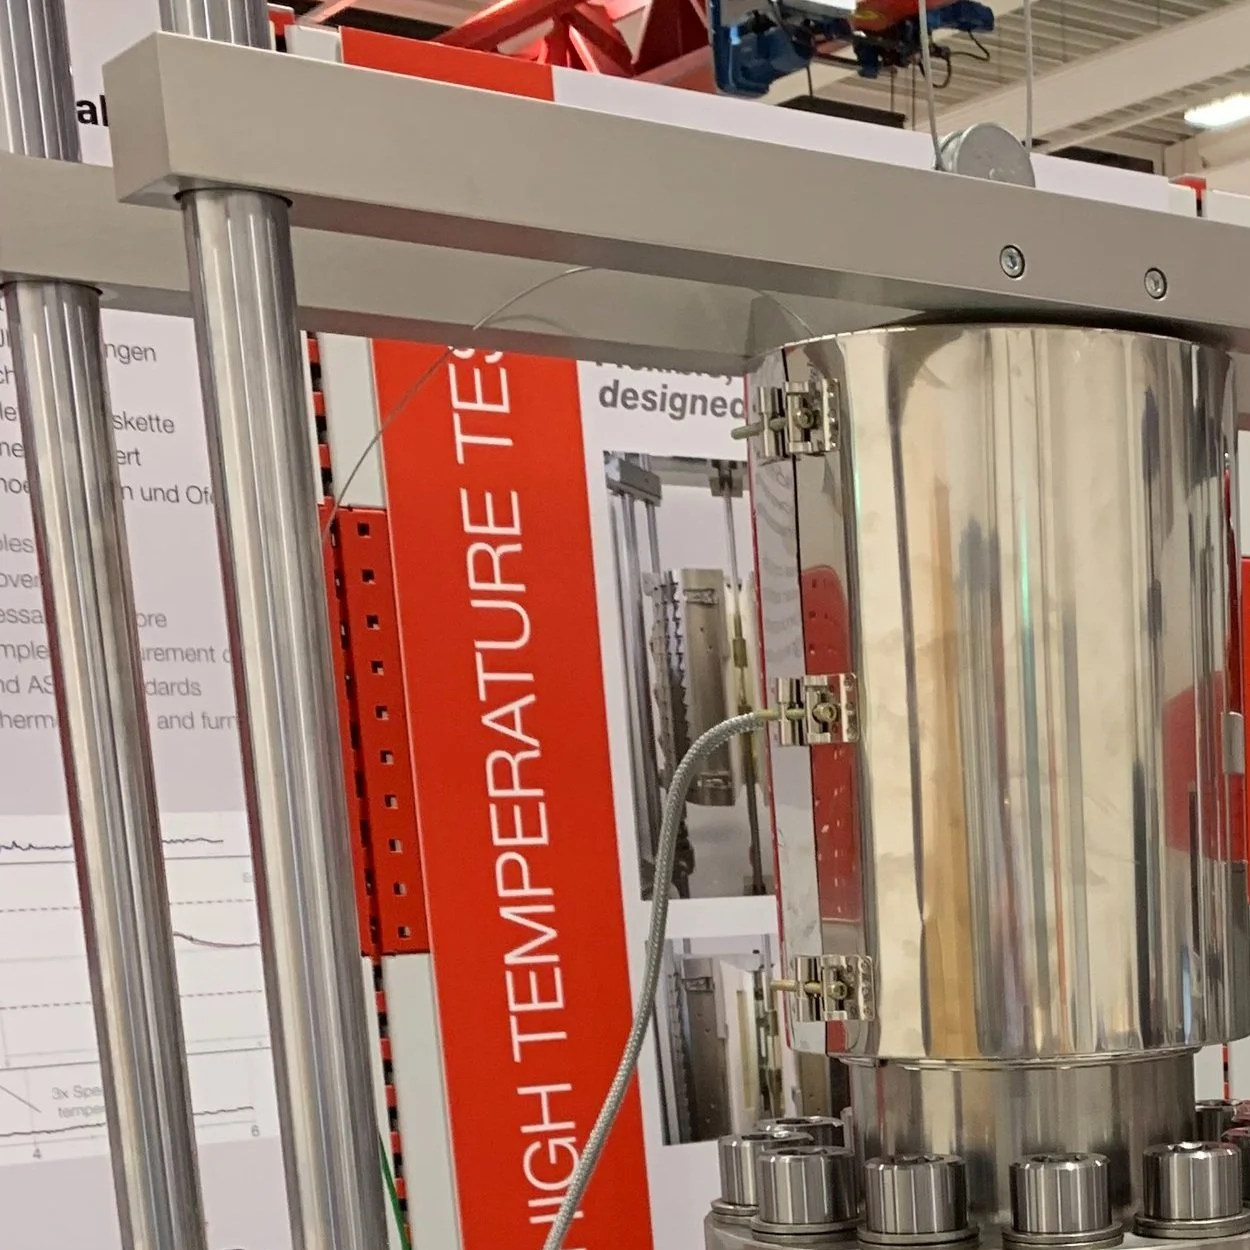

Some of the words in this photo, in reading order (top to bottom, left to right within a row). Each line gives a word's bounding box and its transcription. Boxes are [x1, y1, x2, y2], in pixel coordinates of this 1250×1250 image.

[140, 484, 179, 503] und
[157, 711, 195, 730] and
[459, 488, 567, 1063] TEMPERATURE
